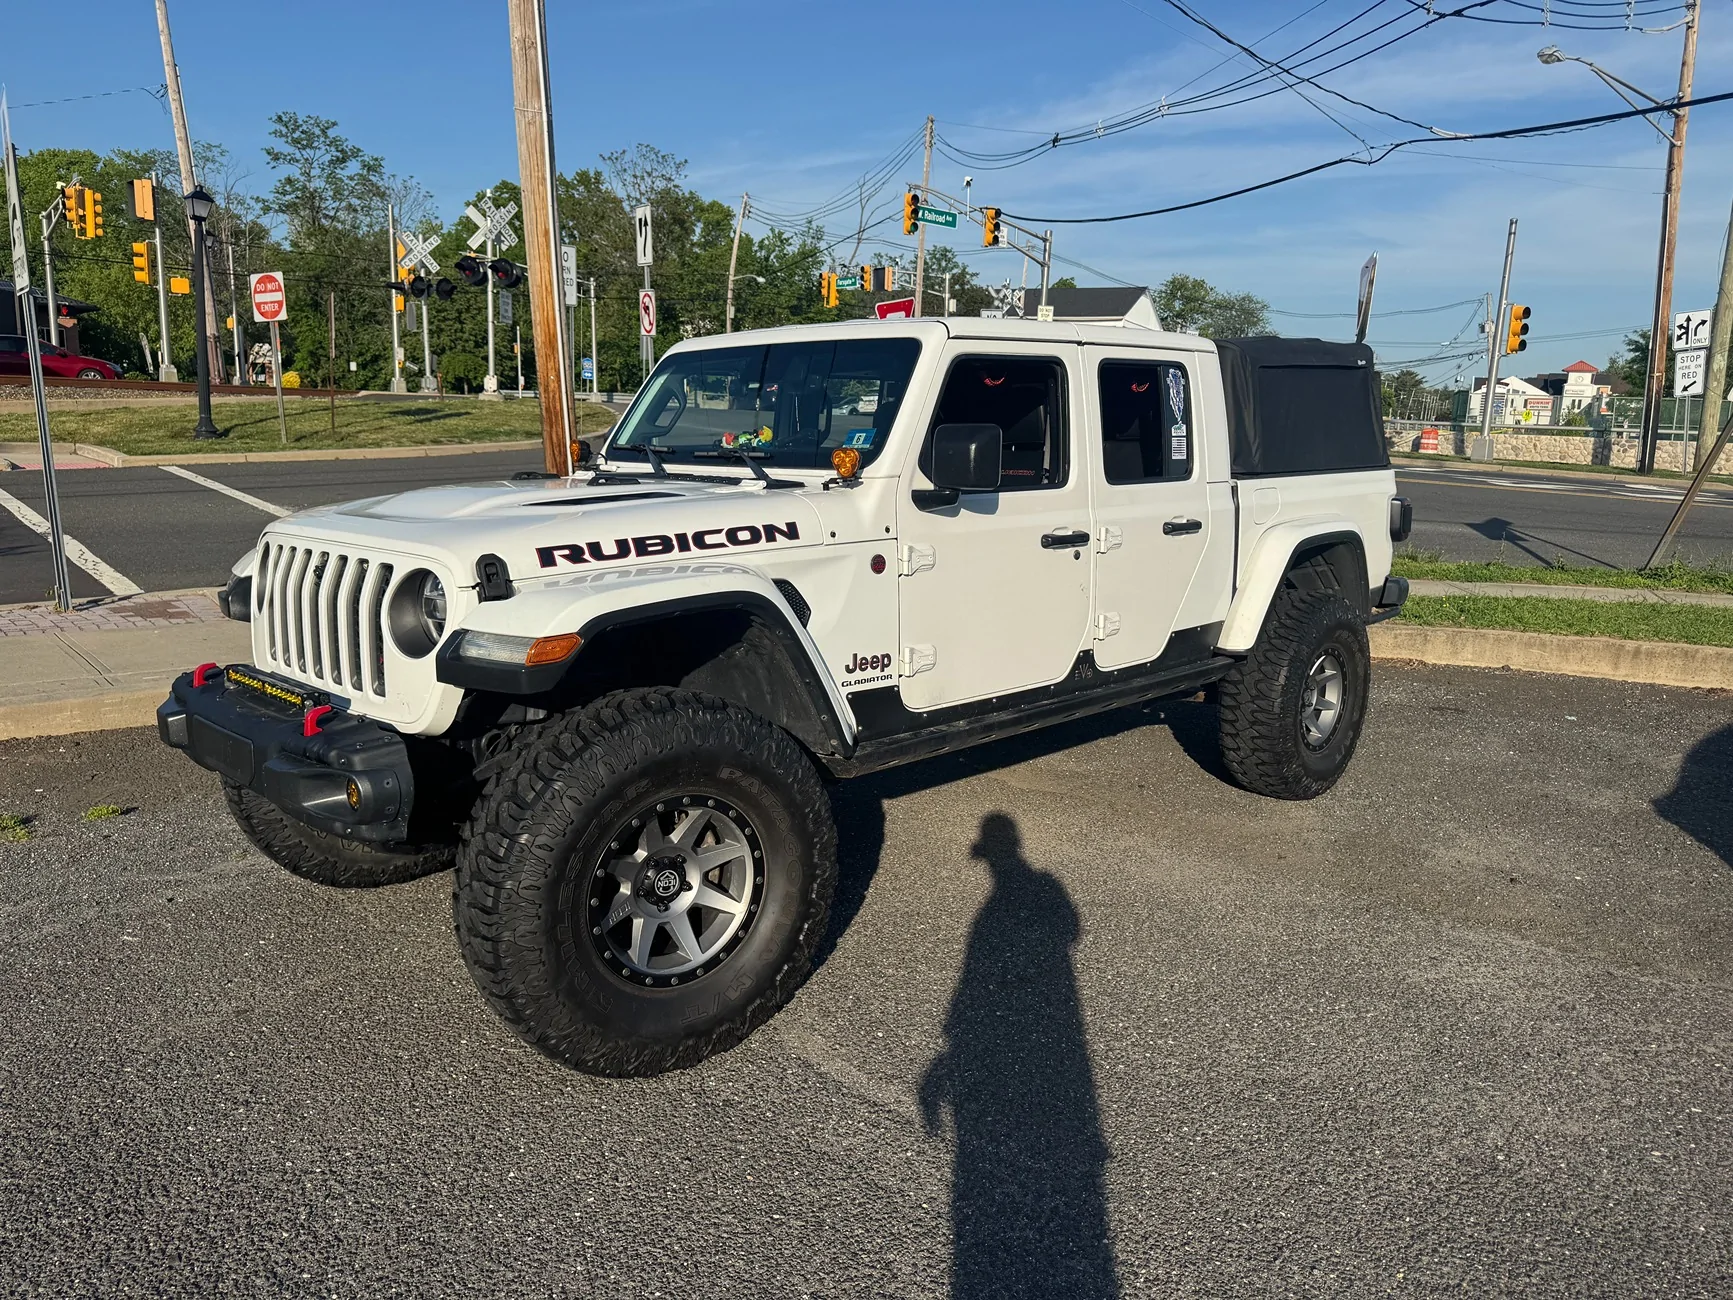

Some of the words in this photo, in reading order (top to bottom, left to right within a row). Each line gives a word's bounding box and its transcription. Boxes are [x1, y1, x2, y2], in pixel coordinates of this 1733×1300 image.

[482, 199, 498, 220] RAIL
[924, 210, 946, 224] Railroad
[484, 203, 517, 240] CROSSING
[404, 232, 420, 251] RAIL
[501, 224, 517, 244] ROAD
[403, 236, 439, 268] CROSSING
[421, 253, 438, 272] ROAD
[256, 283, 265, 292] DO
[267, 281, 279, 291] NOT
[260, 302, 280, 312] ENTER
[1692, 337, 1708, 345] ONLY
[1680, 354, 1701, 364] STOP
[1681, 371, 1698, 380] RED
[535, 521, 800, 569] RUBICON
[844, 652, 892, 674] Jeep
[841, 673, 893, 688] GLADIATOR
